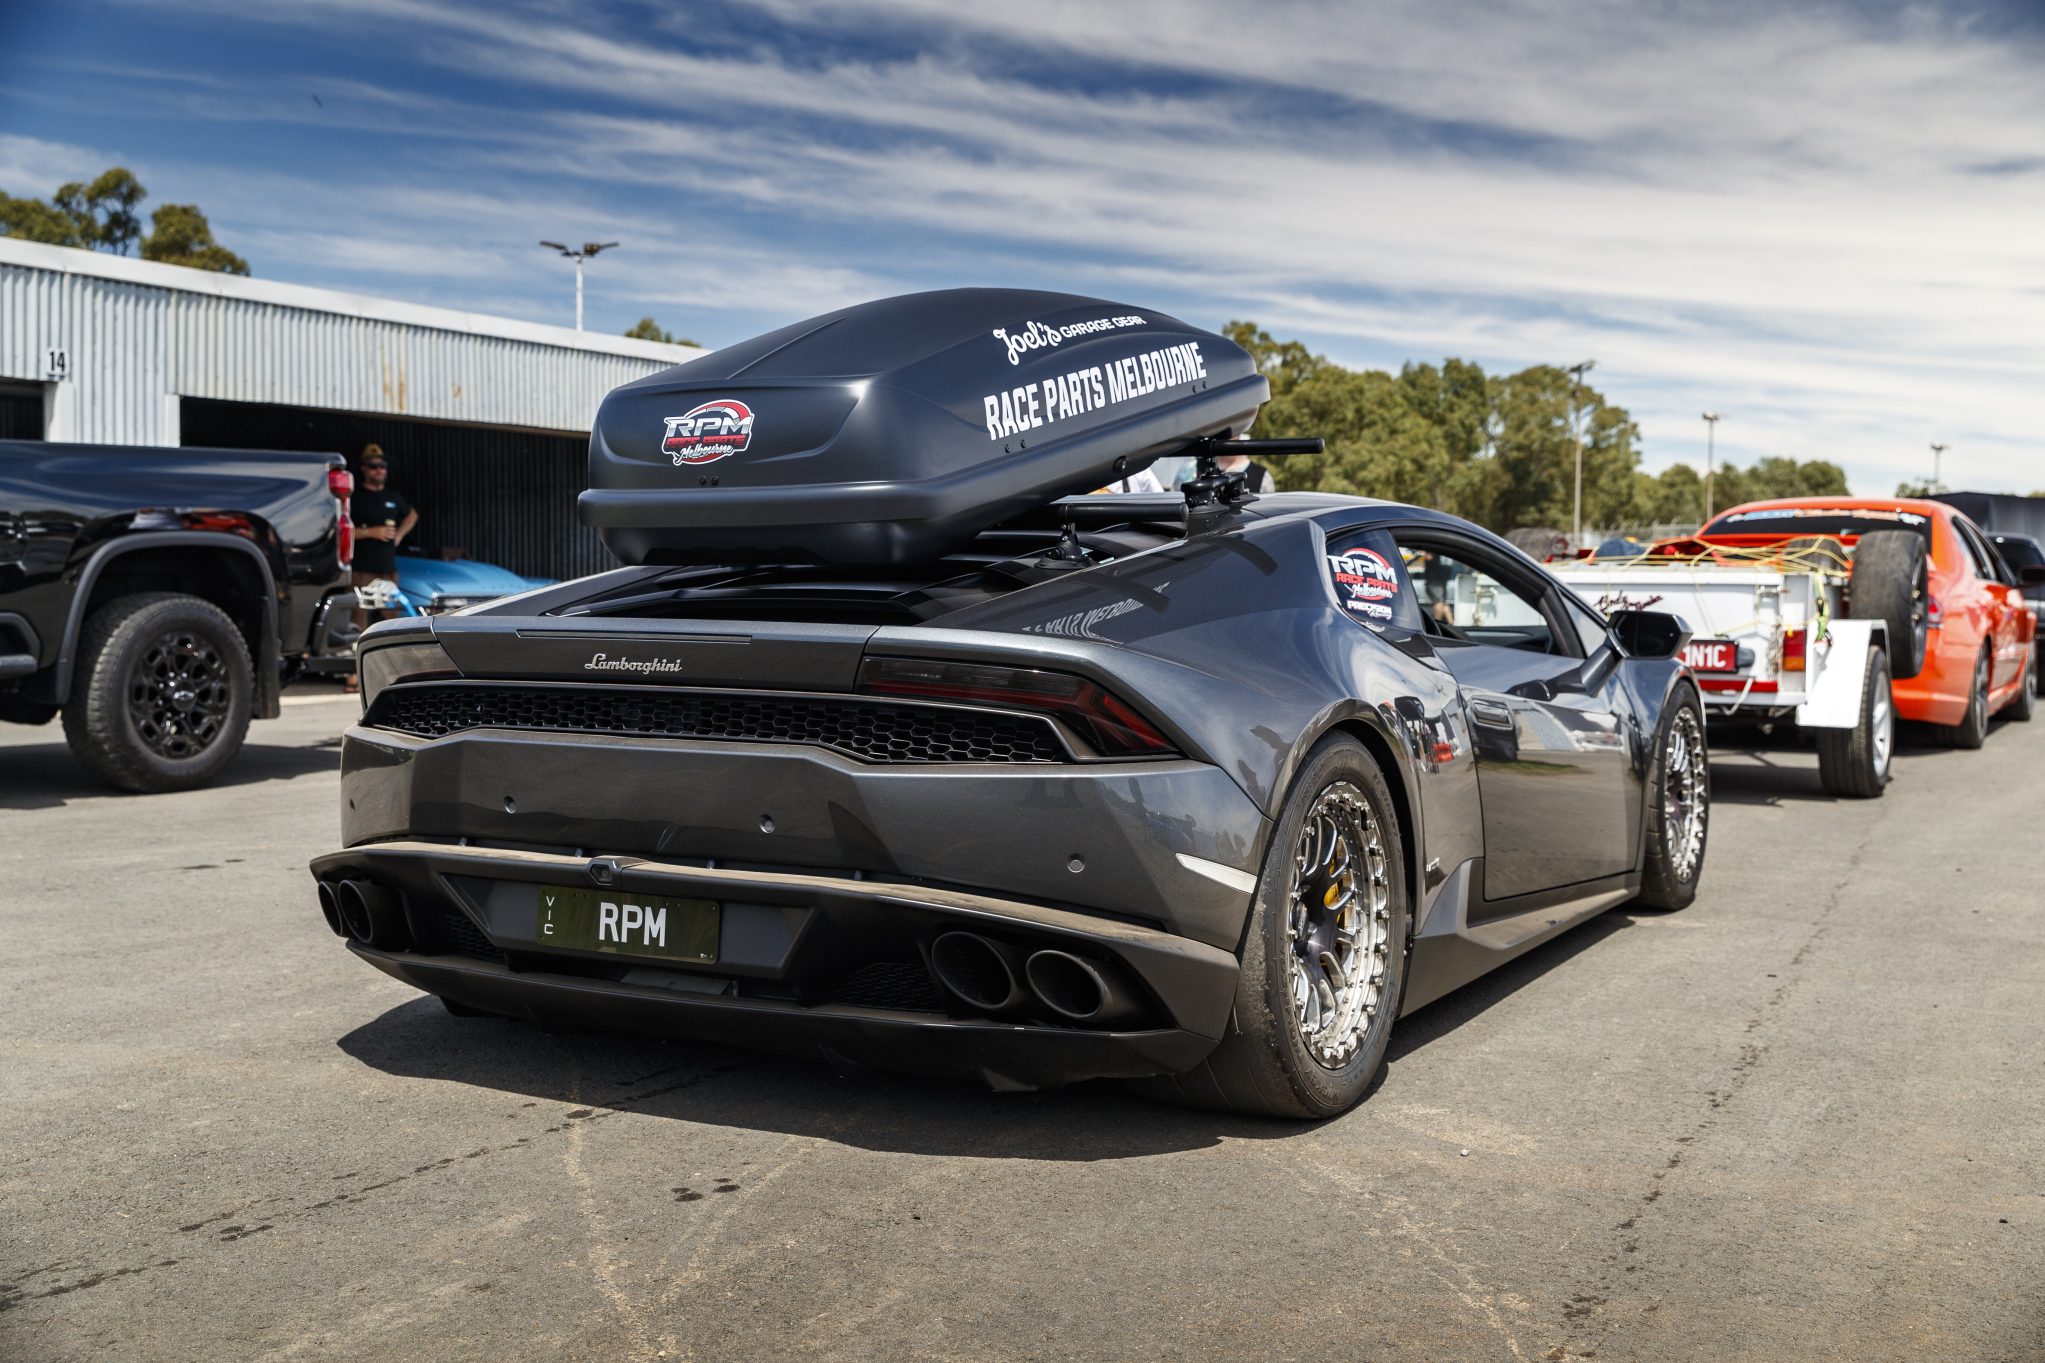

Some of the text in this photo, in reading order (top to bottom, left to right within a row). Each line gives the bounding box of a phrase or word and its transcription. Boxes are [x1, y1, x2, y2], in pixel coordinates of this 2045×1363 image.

[992, 315, 1147, 365] Joel's GARAGE GEAR
[50, 351, 66, 372] 14
[983, 341, 1207, 441] RACE PARTS MELBOURNE
[665, 416, 754, 437] RPM
[674, 443, 733, 465] Melbourne
[1326, 554, 1398, 585] RPM
[1335, 572, 1365, 586] RACE
[584, 653, 682, 675] Lamborghini
[544, 895, 556, 935] VIC
[598, 901, 667, 947] RPM
